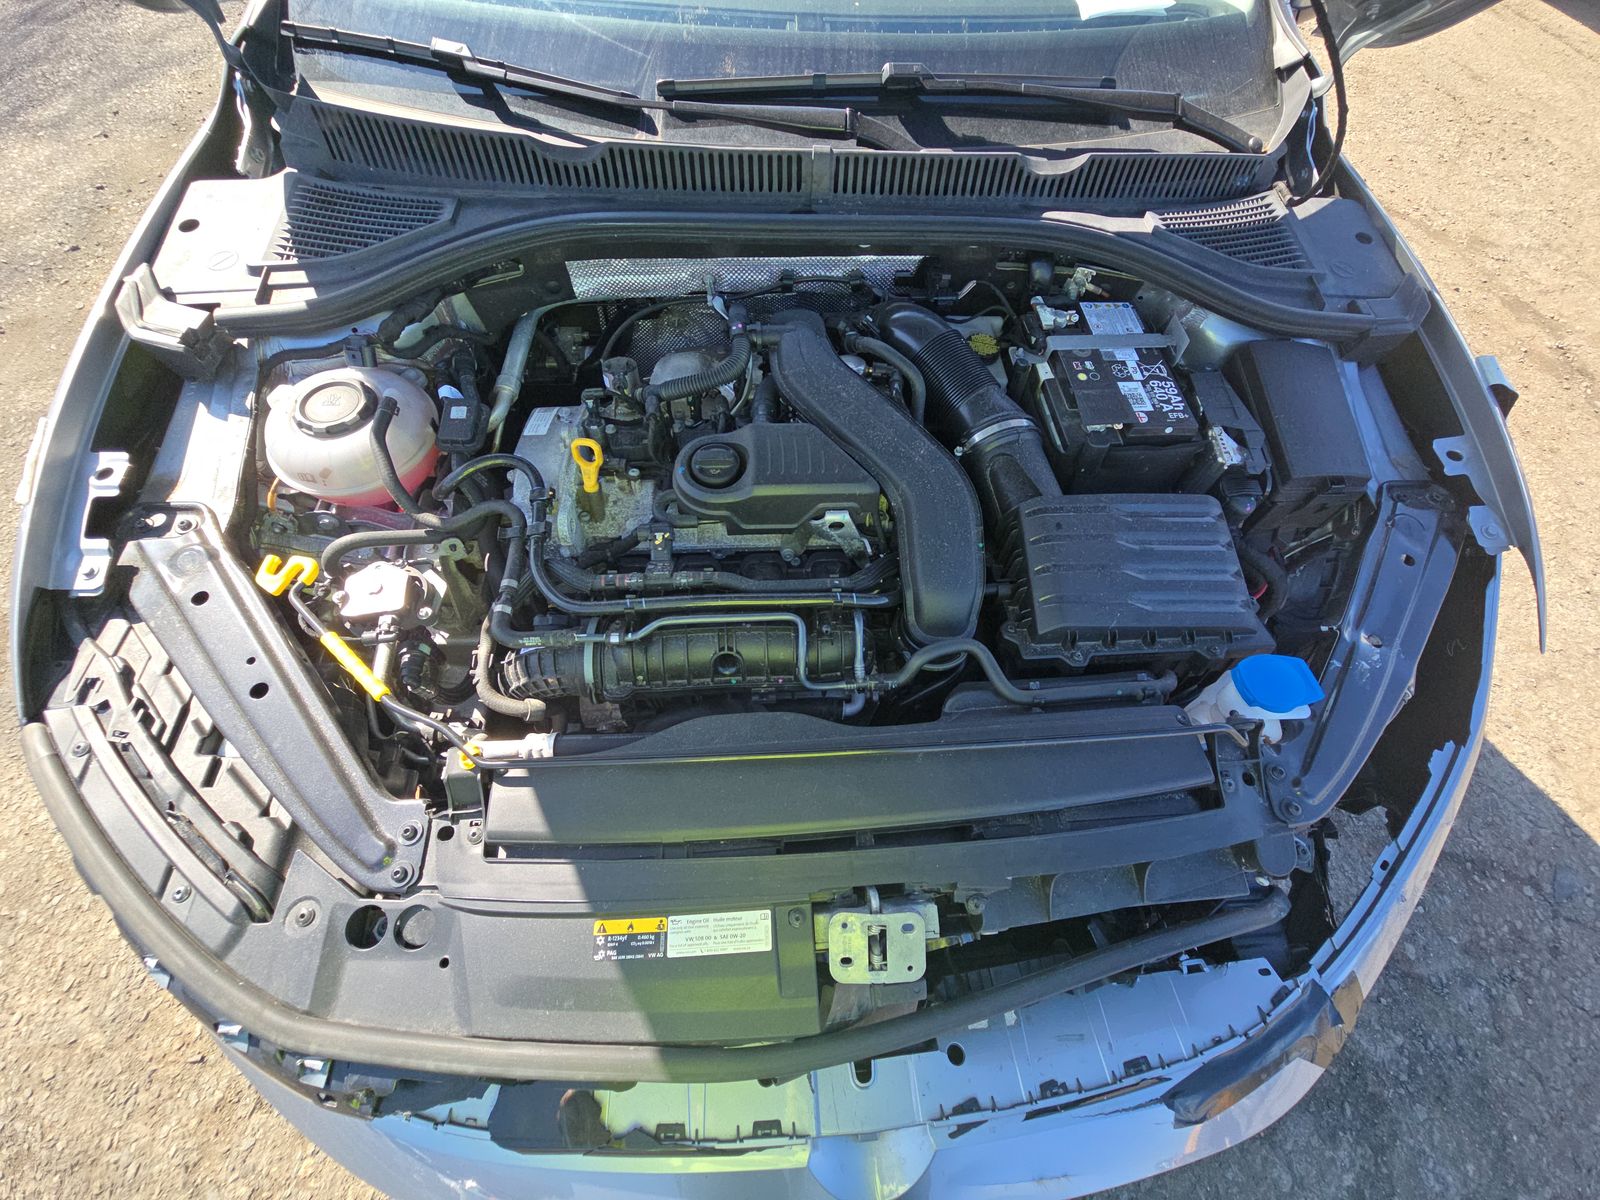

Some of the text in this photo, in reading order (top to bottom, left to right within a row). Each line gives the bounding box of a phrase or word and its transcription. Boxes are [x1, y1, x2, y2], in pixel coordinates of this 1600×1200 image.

[1149, 380, 1169, 400] 640
[1160, 402, 1174, 412] A
[1162, 380, 1185, 411] 59Ah
[686, 918, 702, 926] Engine
